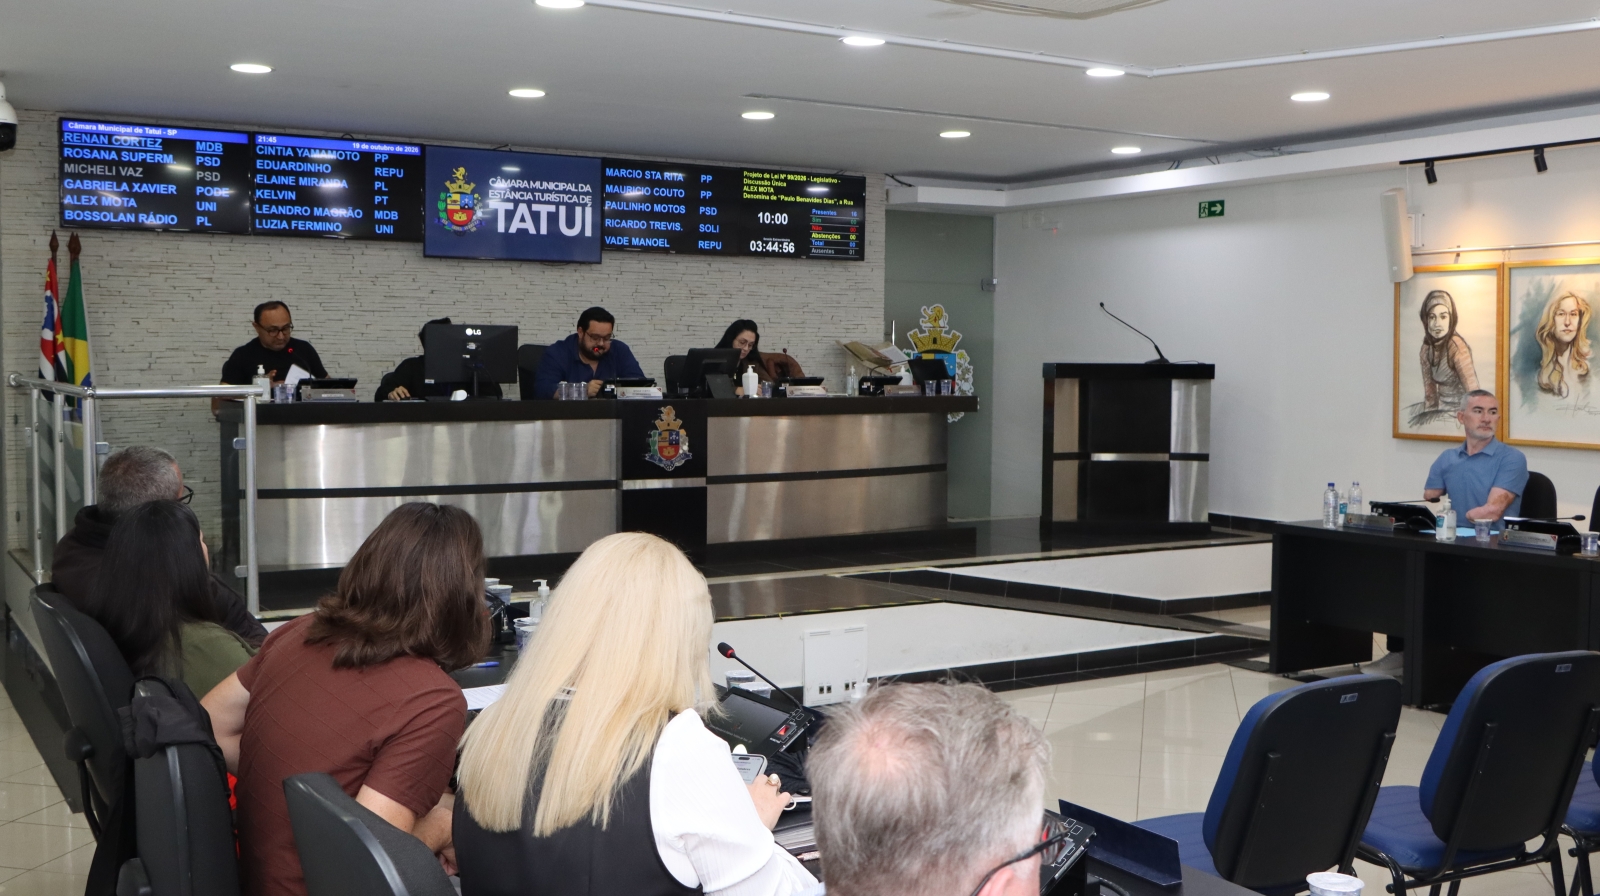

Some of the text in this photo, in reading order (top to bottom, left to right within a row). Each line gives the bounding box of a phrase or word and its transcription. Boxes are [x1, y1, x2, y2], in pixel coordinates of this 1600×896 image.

[98, 125, 132, 133] Municipal
[64, 133, 223, 152] RENAN CORTEZ MDB
[64, 148, 220, 166] ROSANA SUPERM. PSD
[256, 146, 388, 162] CINTIA YAMAMOTO PP
[64, 164, 220, 181] MICHELI VAZ PSD
[256, 160, 403, 177] EDUARDINHO REPU
[606, 168, 642, 178] MARCIO
[645, 171, 661, 180] STA
[664, 172, 683, 181] RITA
[64, 179, 229, 197] GABRIELA XAVIER PODE
[256, 175, 388, 191] ELAINE MIRANDA PL
[489, 176, 592, 192] CÂMARA MUNICIPAL DA
[256, 190, 388, 205] KELVIN PT
[489, 189, 533, 200] ESTÂNCIA
[534, 191, 580, 203] TURÍSTICA
[606, 185, 651, 195] MAURICIO
[654, 188, 684, 197] COUTO
[64, 195, 216, 211] ALEX MOTA UNI
[605, 201, 717, 215] PAULINHO MOTOS PSD
[65, 210, 212, 226] BOSSOLAN RÁDIO PL
[256, 205, 398, 220] LEANDRO MAGRÃO MDB
[489, 201, 592, 236] TATUÍ
[758, 212, 788, 224] 10:00
[256, 220, 393, 234] LUZIA FERMINO UNI
[605, 219, 719, 233] RICARDO TREVIS. SOLI
[605, 236, 722, 249] VADE MANOEL REPU
[750, 241, 794, 253] 03:44:56
